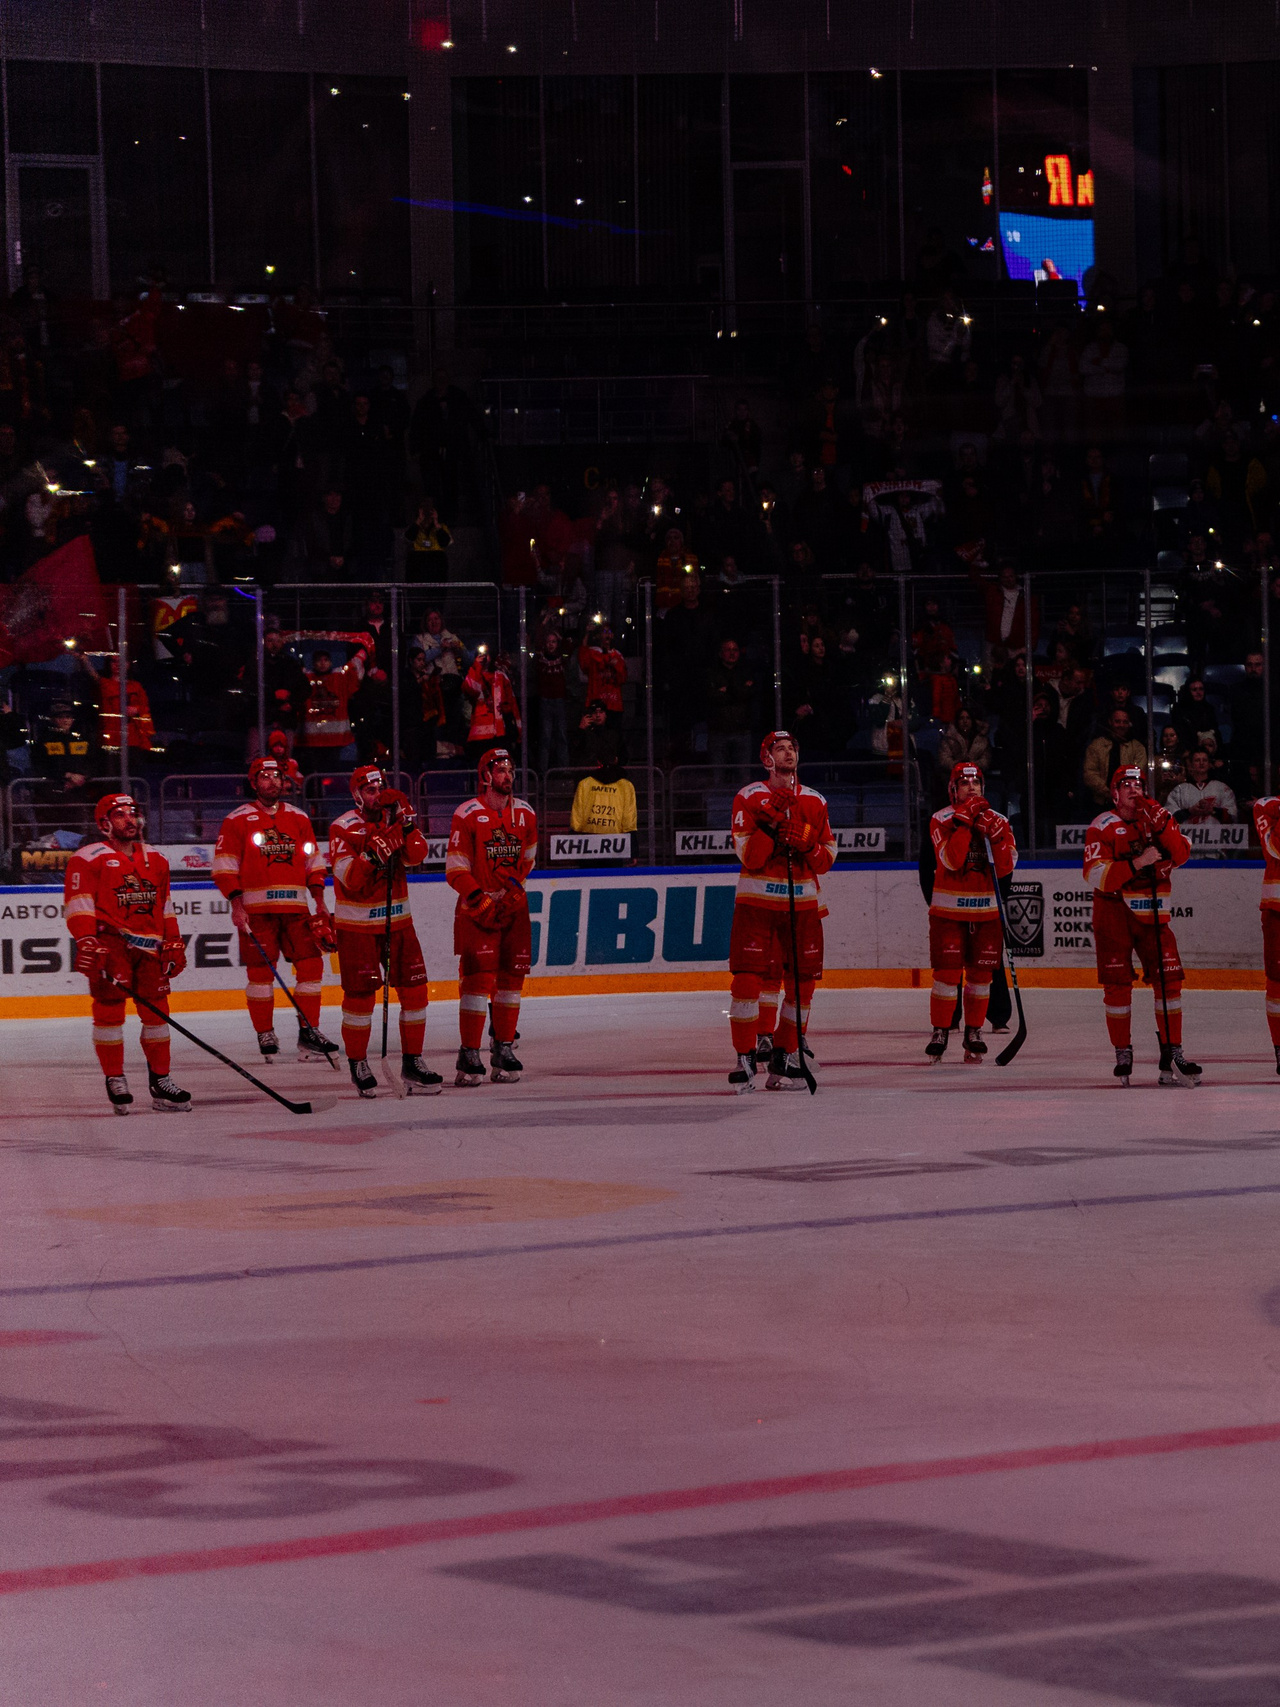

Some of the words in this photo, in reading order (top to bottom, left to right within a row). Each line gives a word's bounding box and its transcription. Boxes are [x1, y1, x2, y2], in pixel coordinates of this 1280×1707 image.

[519, 812, 526, 827] A
[555, 839, 626, 854] KHL.RU
[681, 834, 733, 850] KHL.R
[834, 833, 880, 848] L.RU
[260, 843, 296, 856] REDSTAR
[486, 845, 521, 858] REDSTAR
[1085, 842, 1101, 861] 32
[957, 897, 990, 907] SIBUR
[1053, 892, 1094, 902] ФОНБ
[529, 886, 737, 966] IBU
[1053, 937, 1092, 948] ЛИГА
